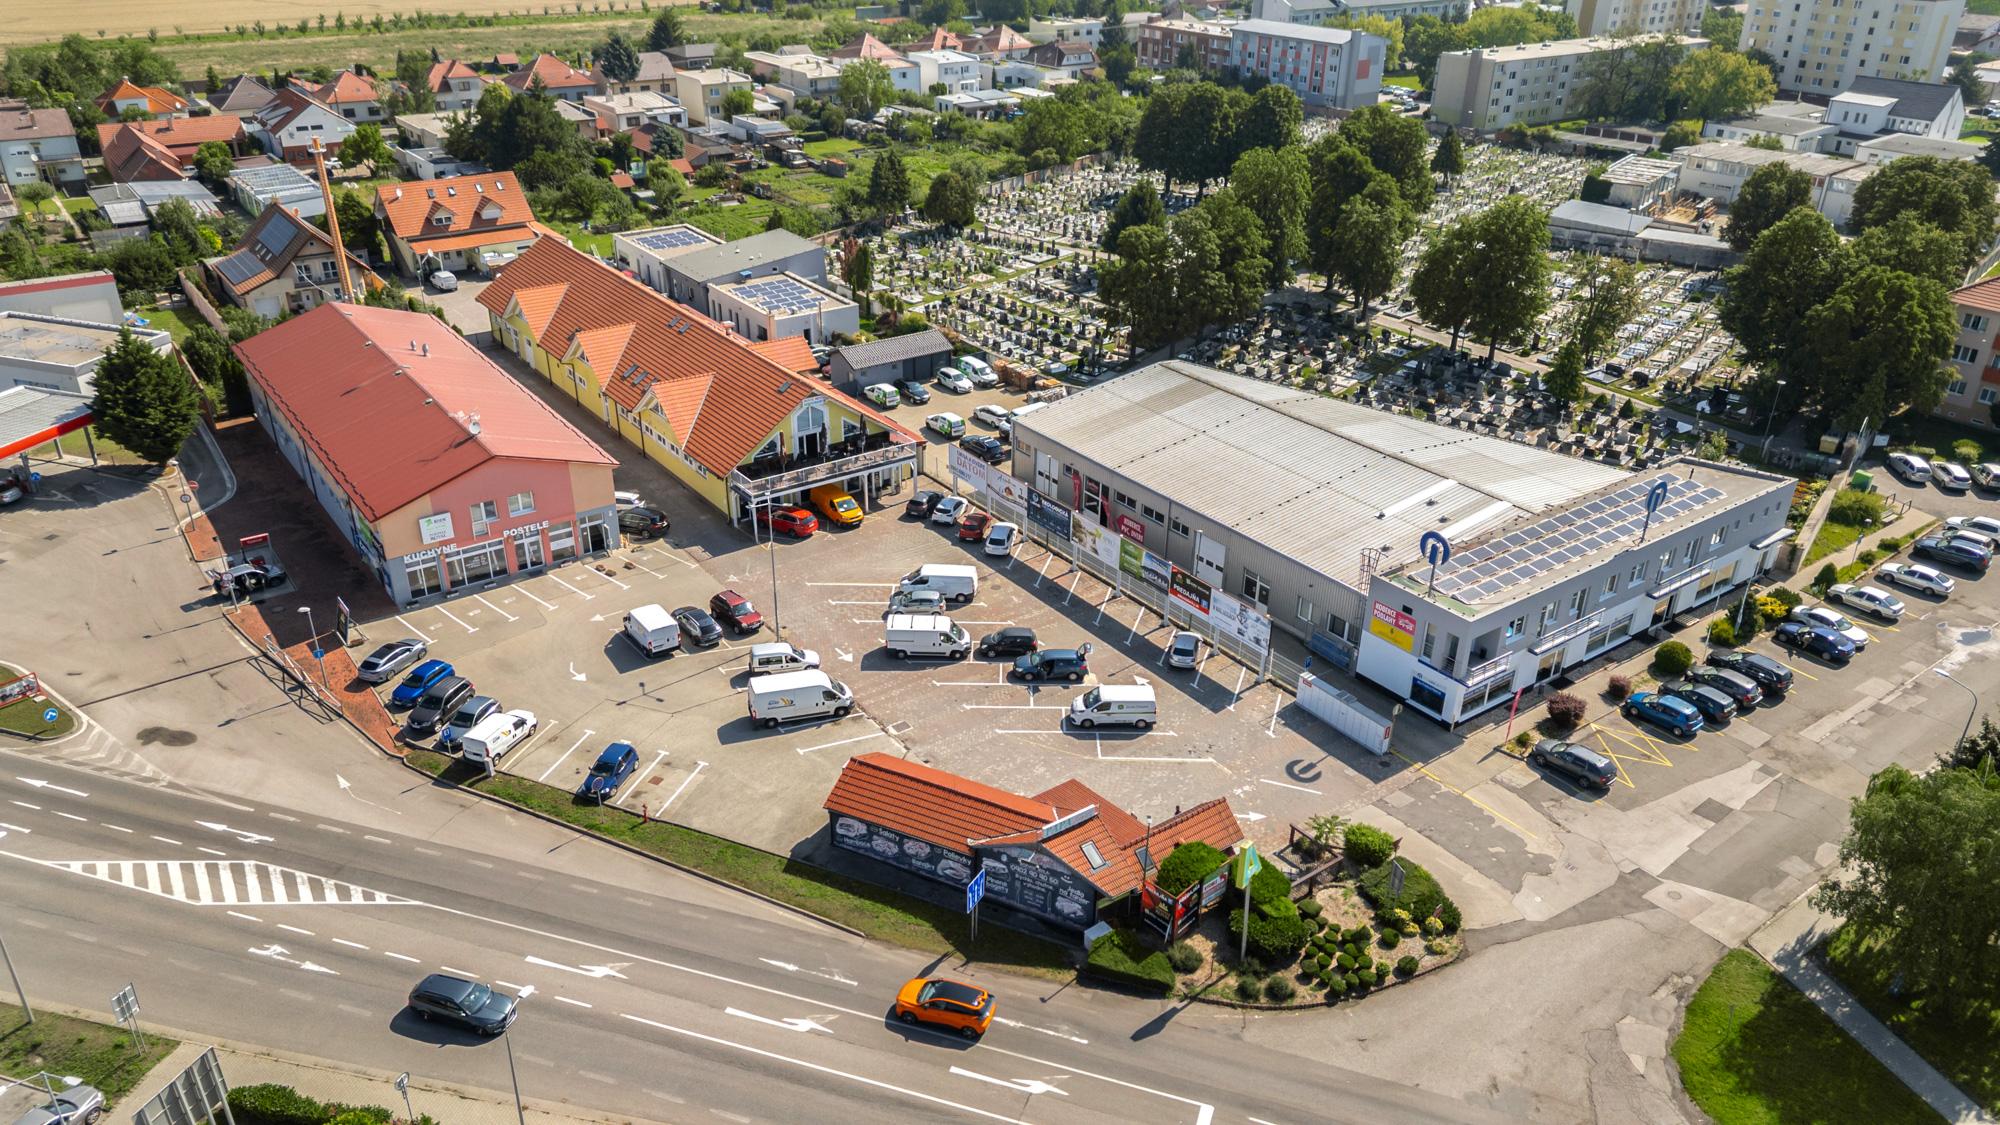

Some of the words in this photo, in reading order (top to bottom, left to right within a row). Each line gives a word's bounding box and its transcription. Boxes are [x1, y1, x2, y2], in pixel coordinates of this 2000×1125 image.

[957, 457, 986, 480] DATOM
[503, 520, 549, 538] POSTELE
[404, 543, 457, 563] KUCHYNE
[1173, 583, 1200, 602] PREDAJŇA
[1374, 609, 1396, 626] PODLAHY
[1375, 602, 1397, 618] KOBERCE
